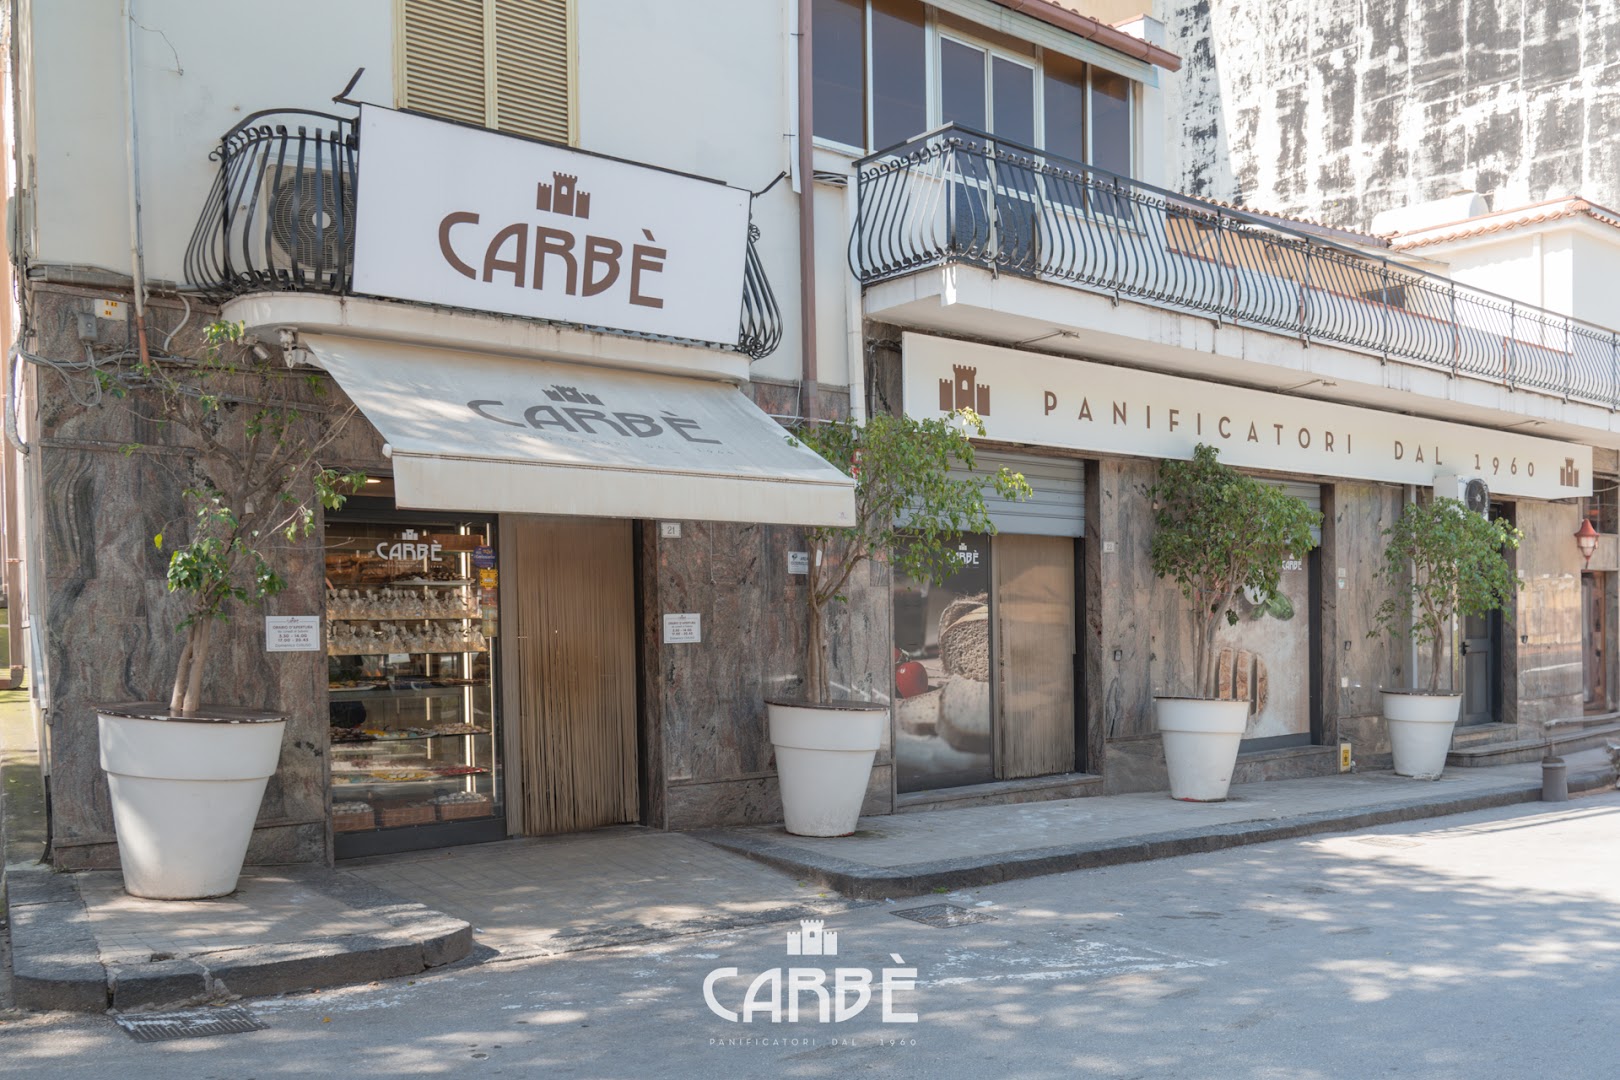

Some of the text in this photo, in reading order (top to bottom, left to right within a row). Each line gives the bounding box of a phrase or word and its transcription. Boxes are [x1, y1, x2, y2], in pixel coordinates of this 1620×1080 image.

[438, 211, 667, 309] CARBÈ
[466, 399, 723, 445] CARBÈ
[1044, 390, 1535, 477] PANIFICATORI DAL 1960
[376, 540, 443, 562] CARBÈ
[667, 525, 675, 535] 21
